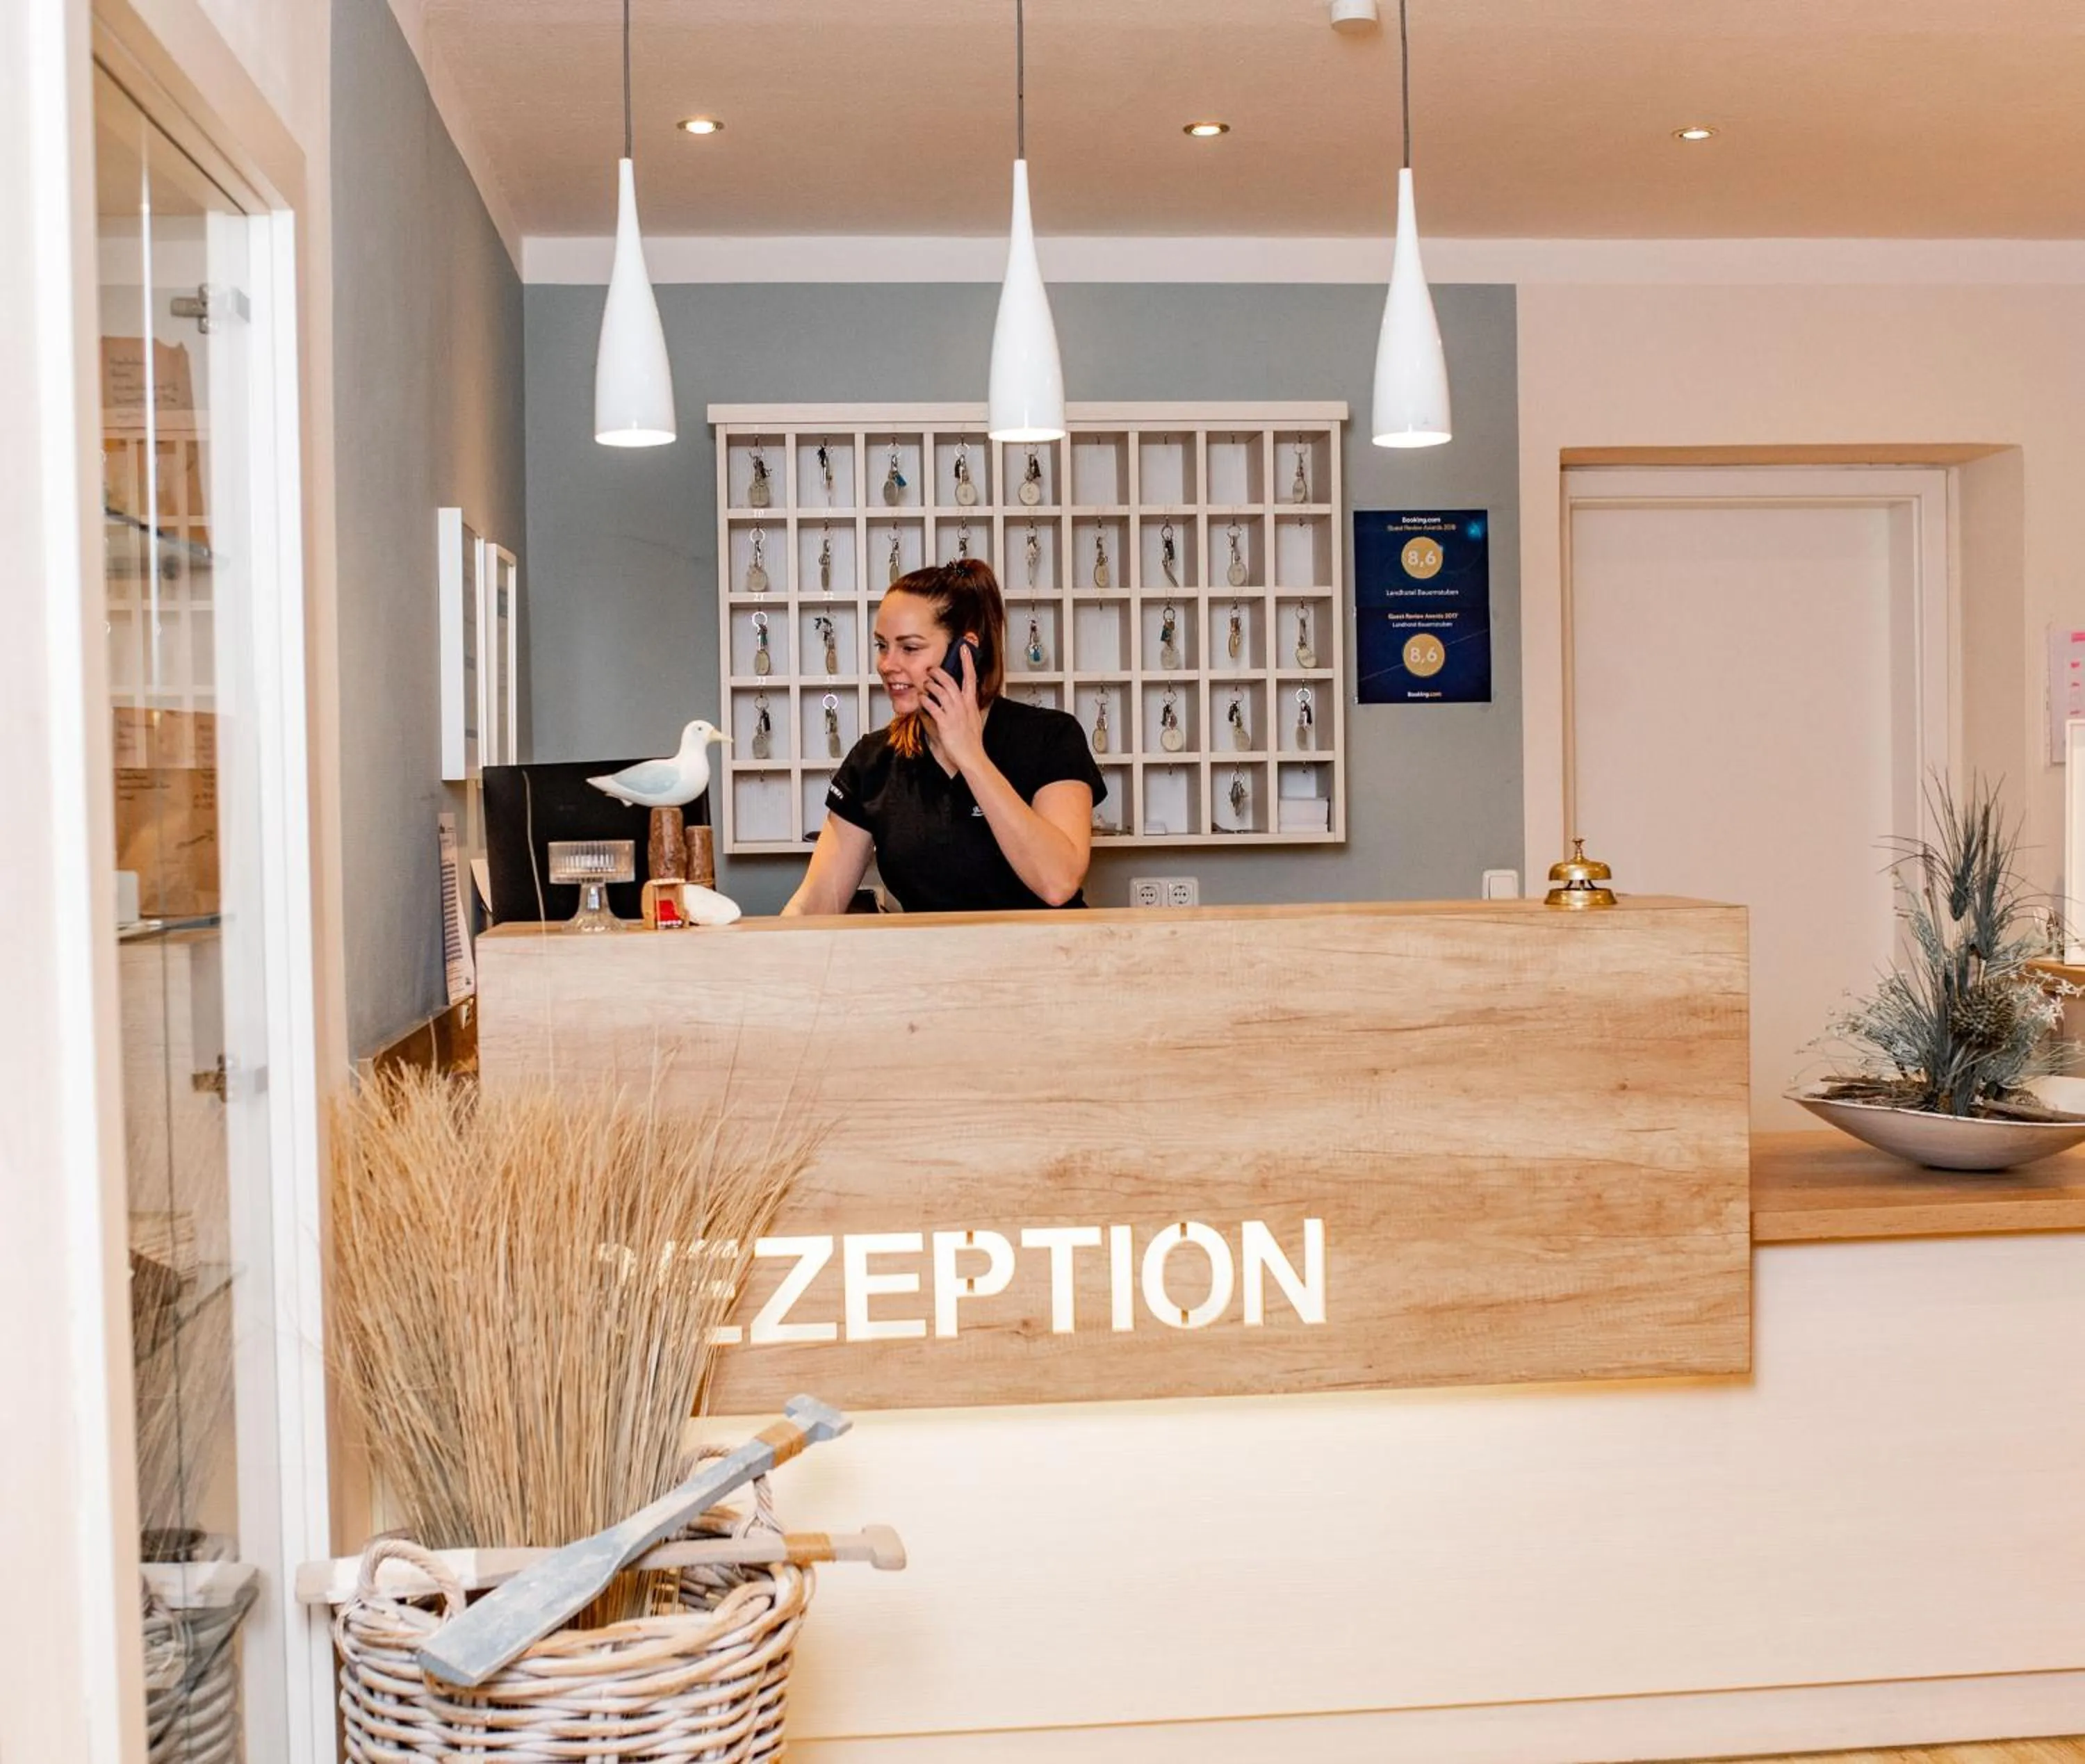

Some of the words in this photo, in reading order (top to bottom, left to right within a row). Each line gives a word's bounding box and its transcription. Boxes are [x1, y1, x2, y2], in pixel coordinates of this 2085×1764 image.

[1408, 550, 1436, 568] 8,6
[1410, 647, 1437, 664] 8,6
[598, 1218, 1327, 1347] ZEPTION
